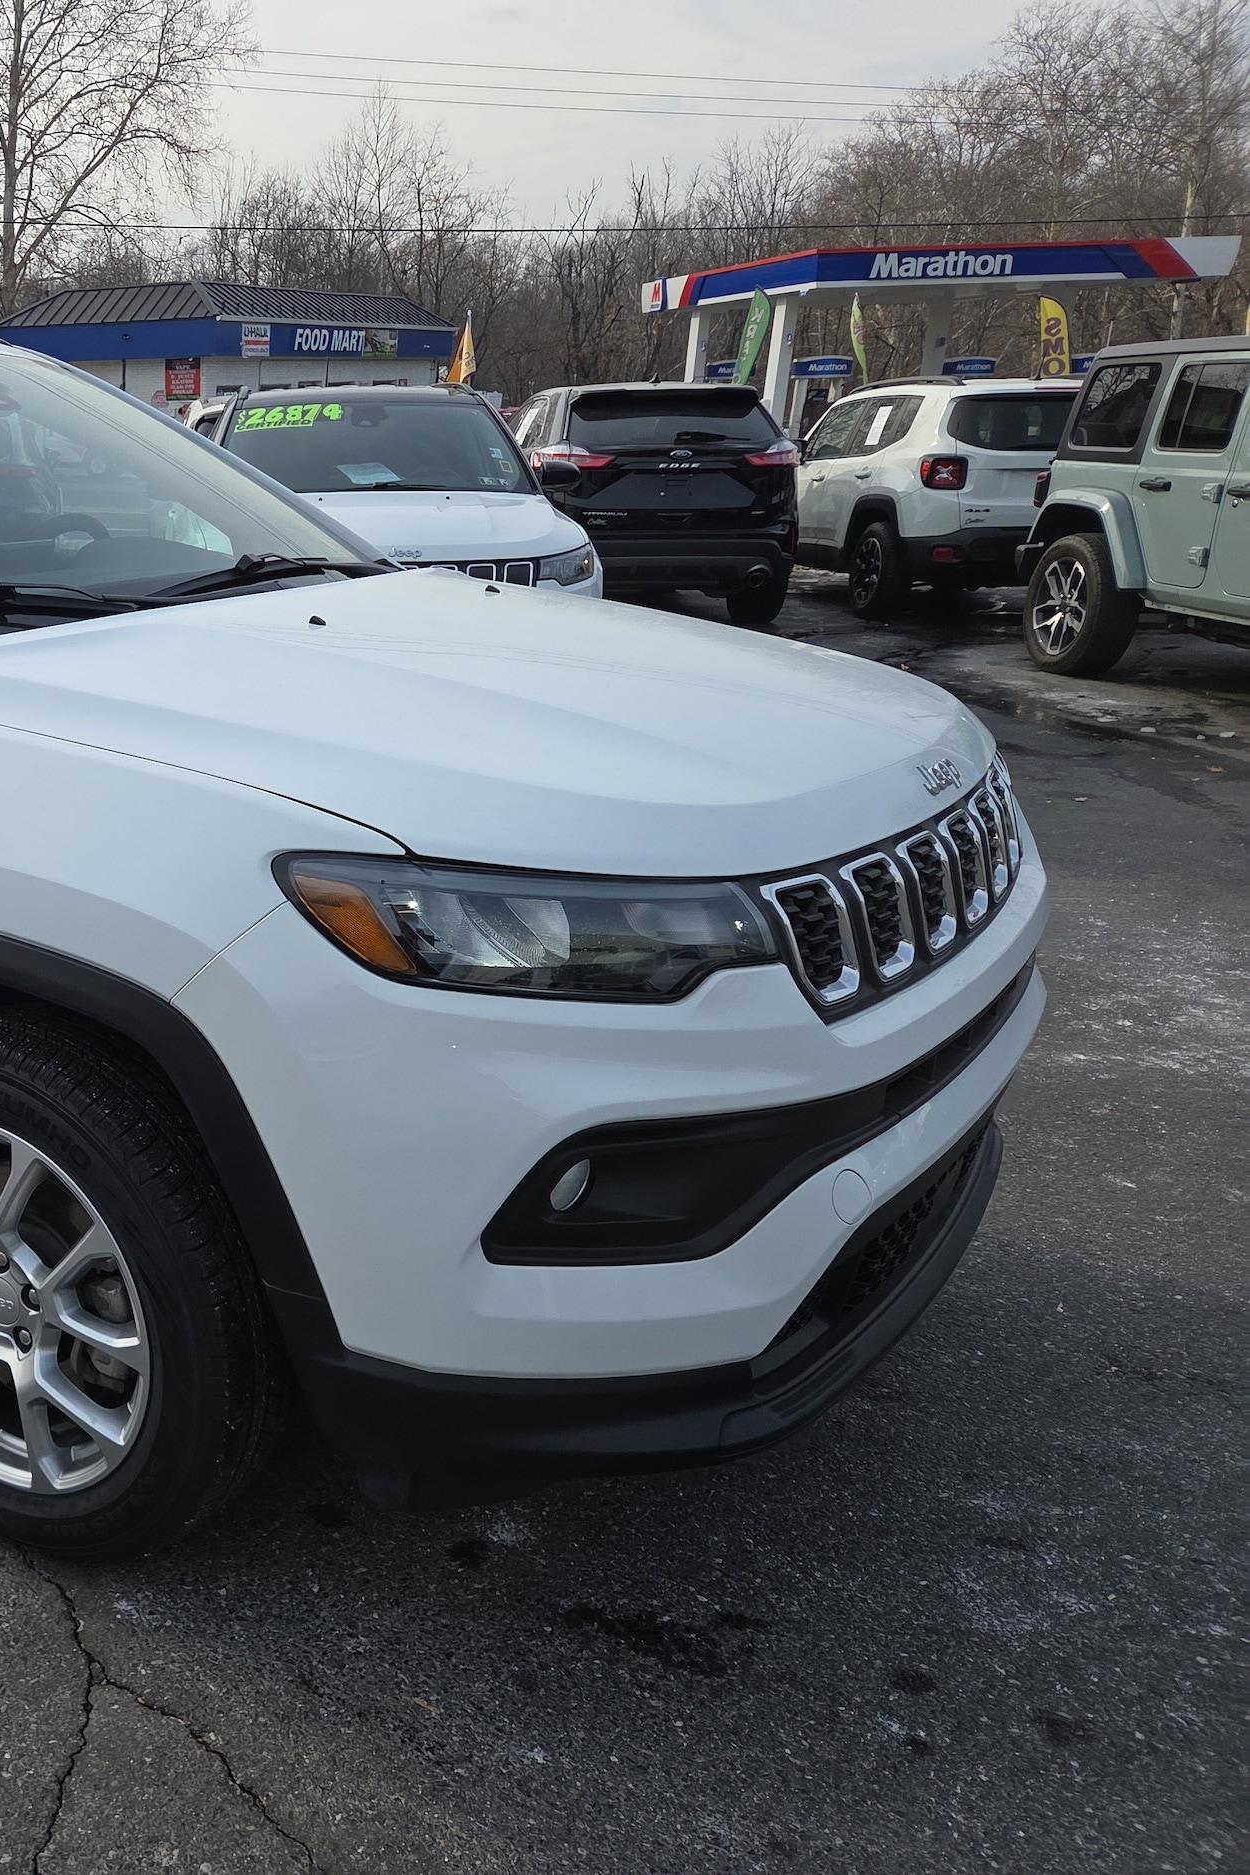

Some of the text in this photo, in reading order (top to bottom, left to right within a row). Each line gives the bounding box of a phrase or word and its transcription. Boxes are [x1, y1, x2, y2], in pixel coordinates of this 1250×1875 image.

[869, 251, 1014, 278] Marathon
[294, 328, 365, 352] FOOD MART
[808, 363, 847, 372] Marathon
[956, 360, 991, 371] Marathon
[238, 403, 344, 425] $26874
[236, 419, 312, 431] CERTIFIED
[388, 547, 422, 560] Jeep
[915, 757, 962, 796] Jeep
